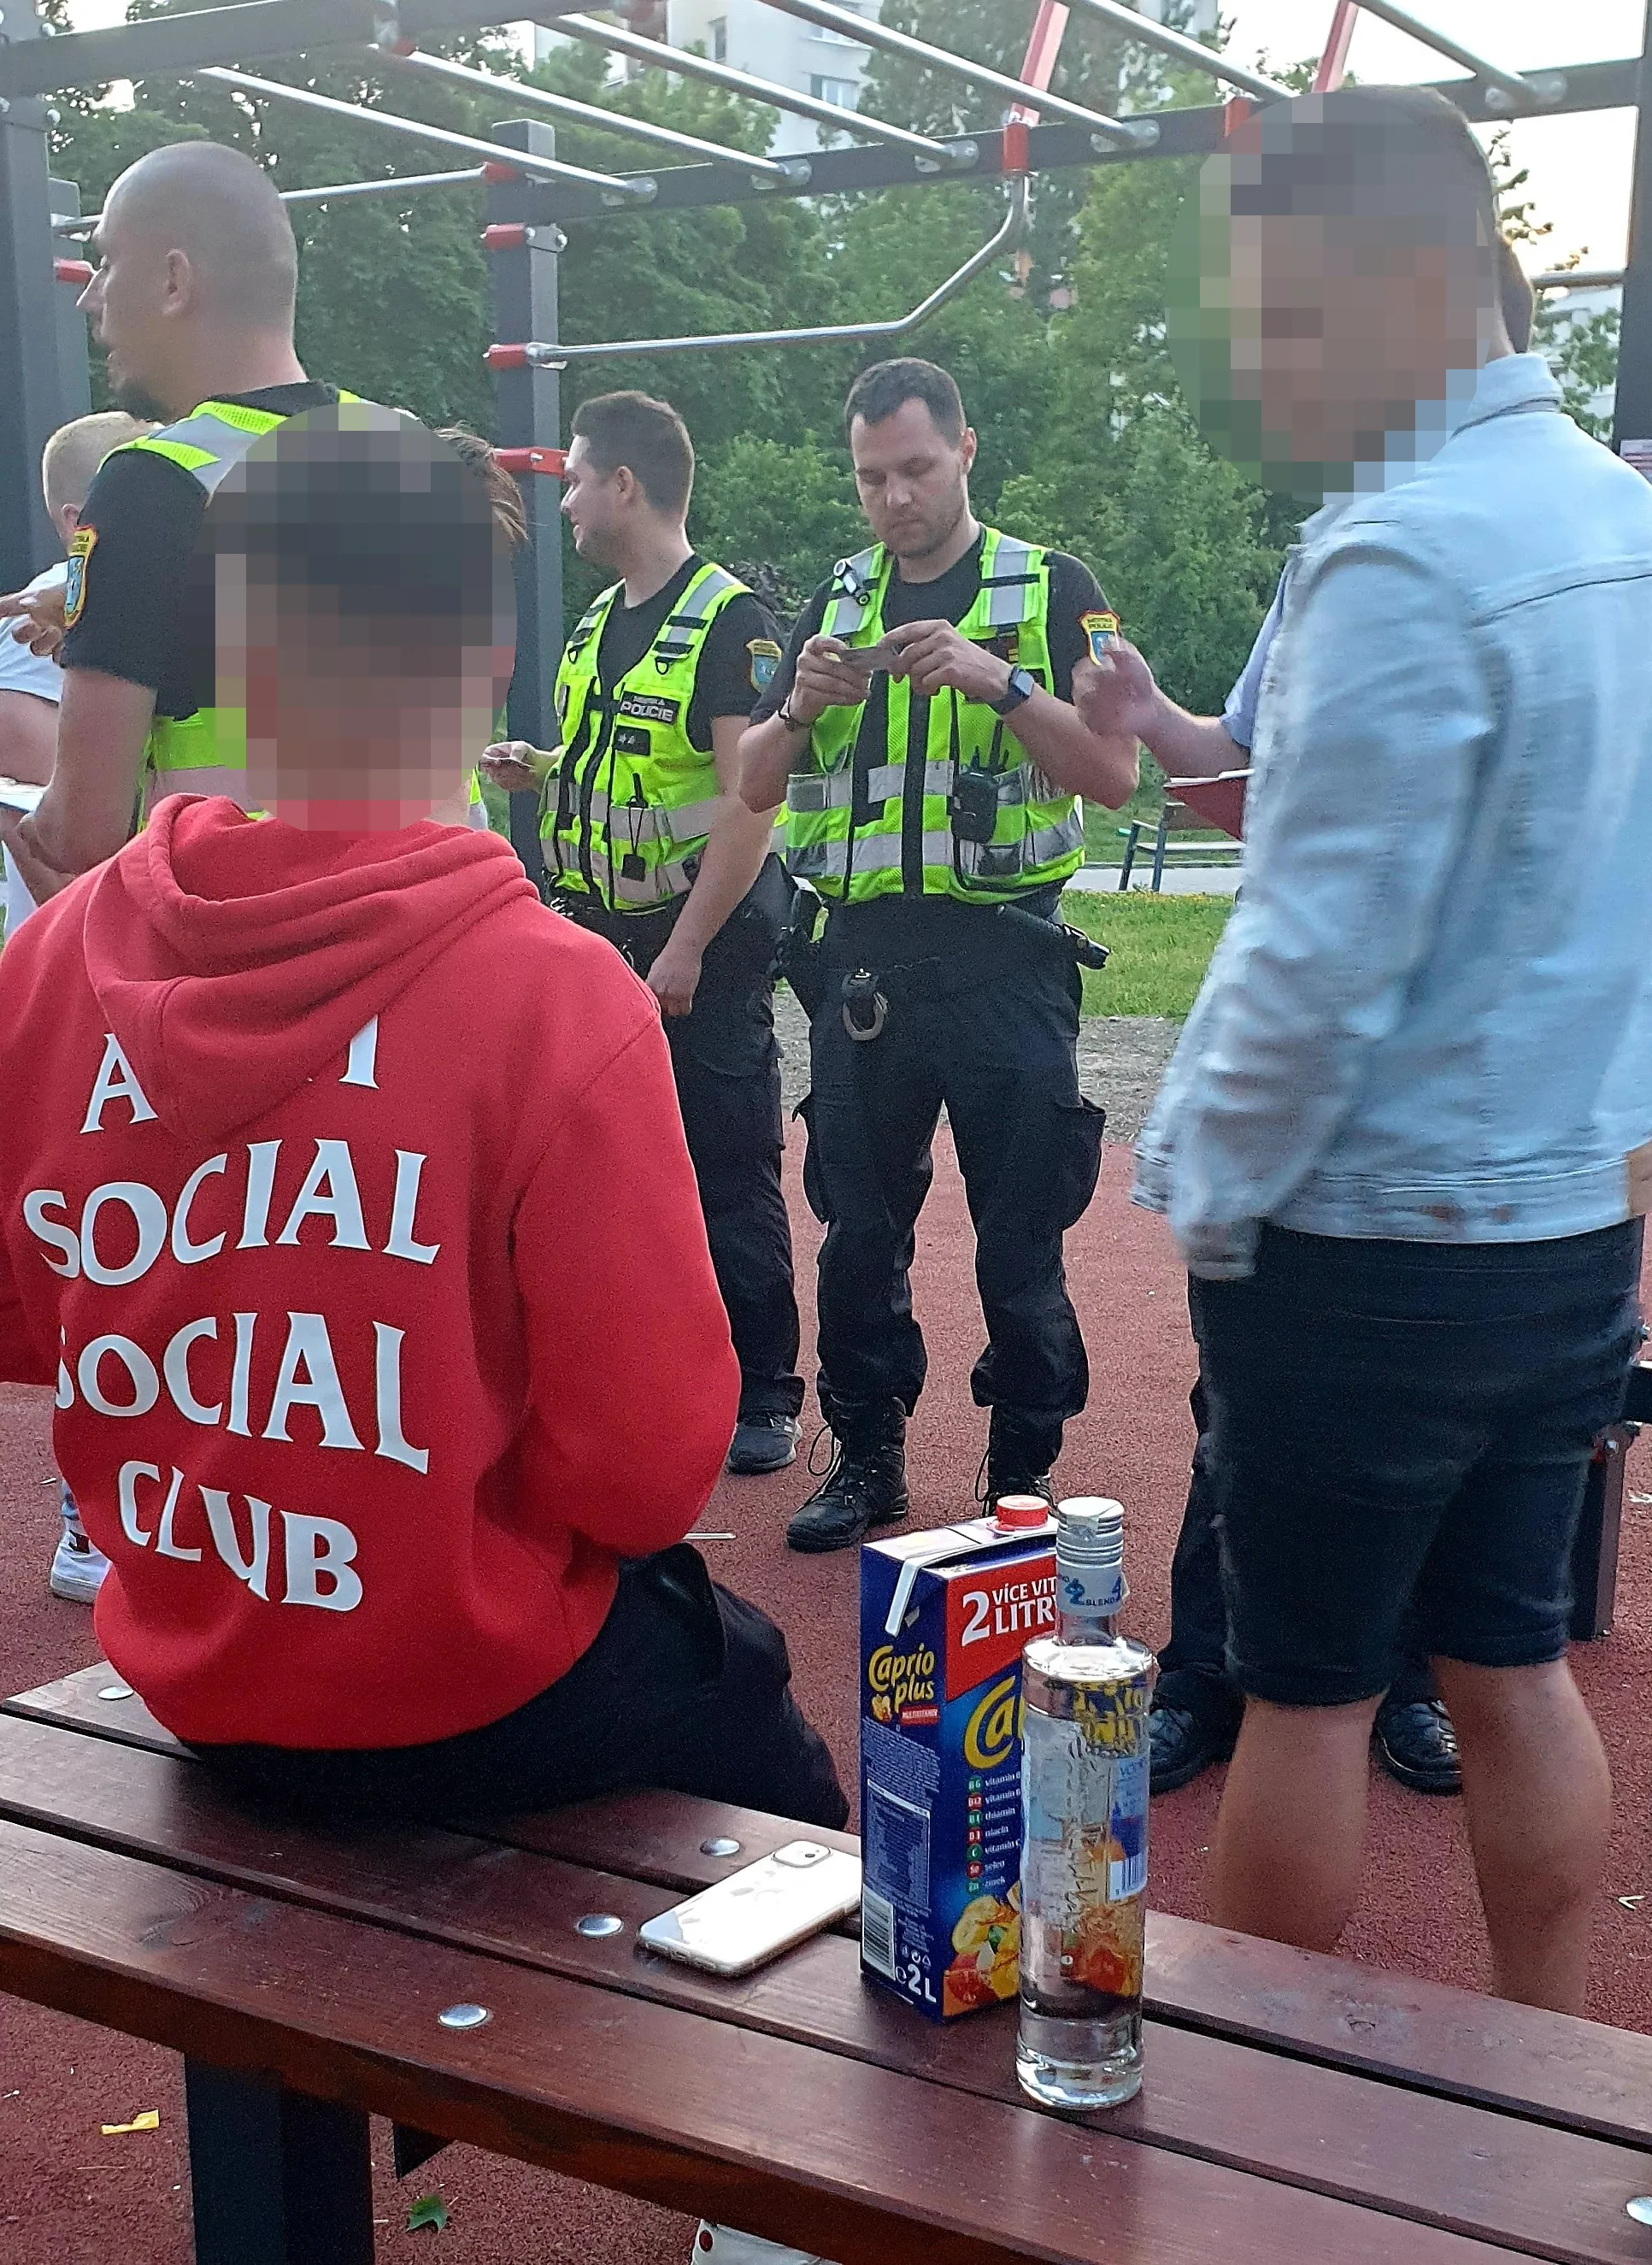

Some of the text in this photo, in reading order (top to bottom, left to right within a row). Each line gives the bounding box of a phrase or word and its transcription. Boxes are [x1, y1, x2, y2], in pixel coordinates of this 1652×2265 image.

[620, 701, 674, 722] POLICIE
[22, 1138, 442, 1286] SOCIAL
[117, 1460, 364, 1613] CLUB
[991, 1582, 1029, 1605] VÍCE
[961, 1590, 991, 1648] 2
[868, 1642, 935, 1691] Caprio
[894, 1673, 934, 1714] plus
